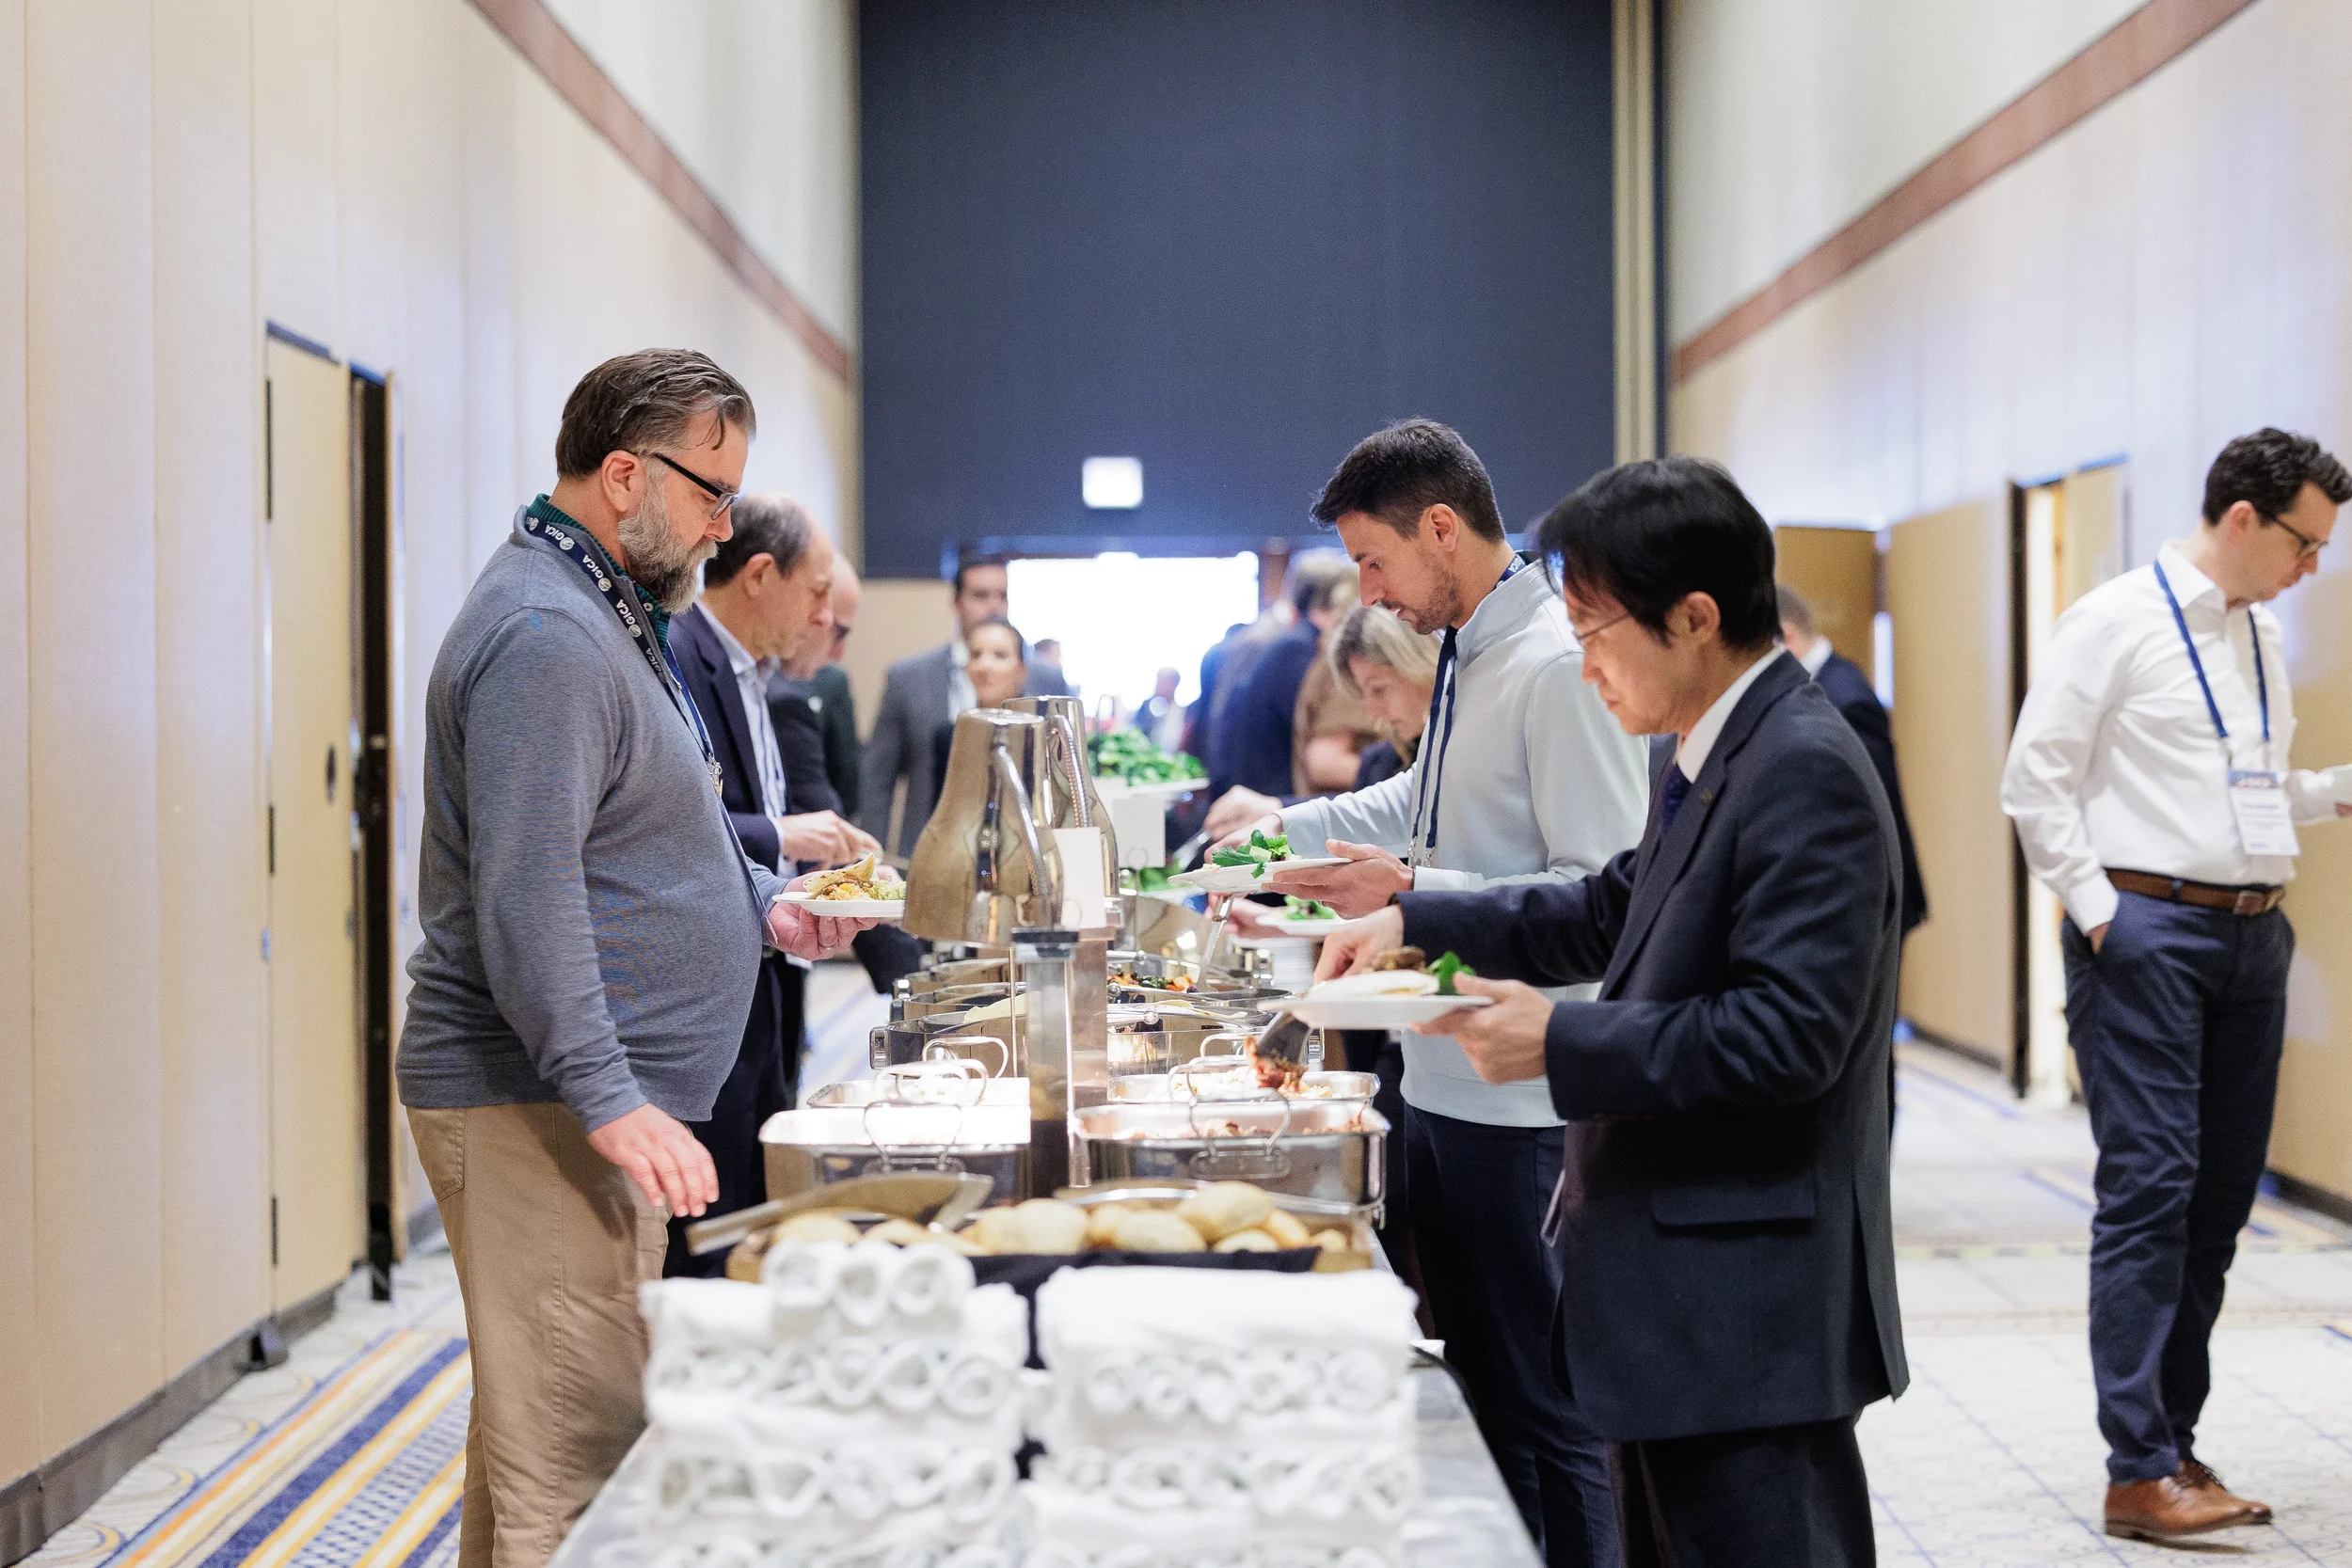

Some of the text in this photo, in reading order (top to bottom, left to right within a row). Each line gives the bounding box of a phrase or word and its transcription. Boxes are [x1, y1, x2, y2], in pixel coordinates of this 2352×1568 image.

[545, 525, 564, 540] GICA
[582, 555, 603, 578] GICA
[616, 599, 635, 625] GICA
